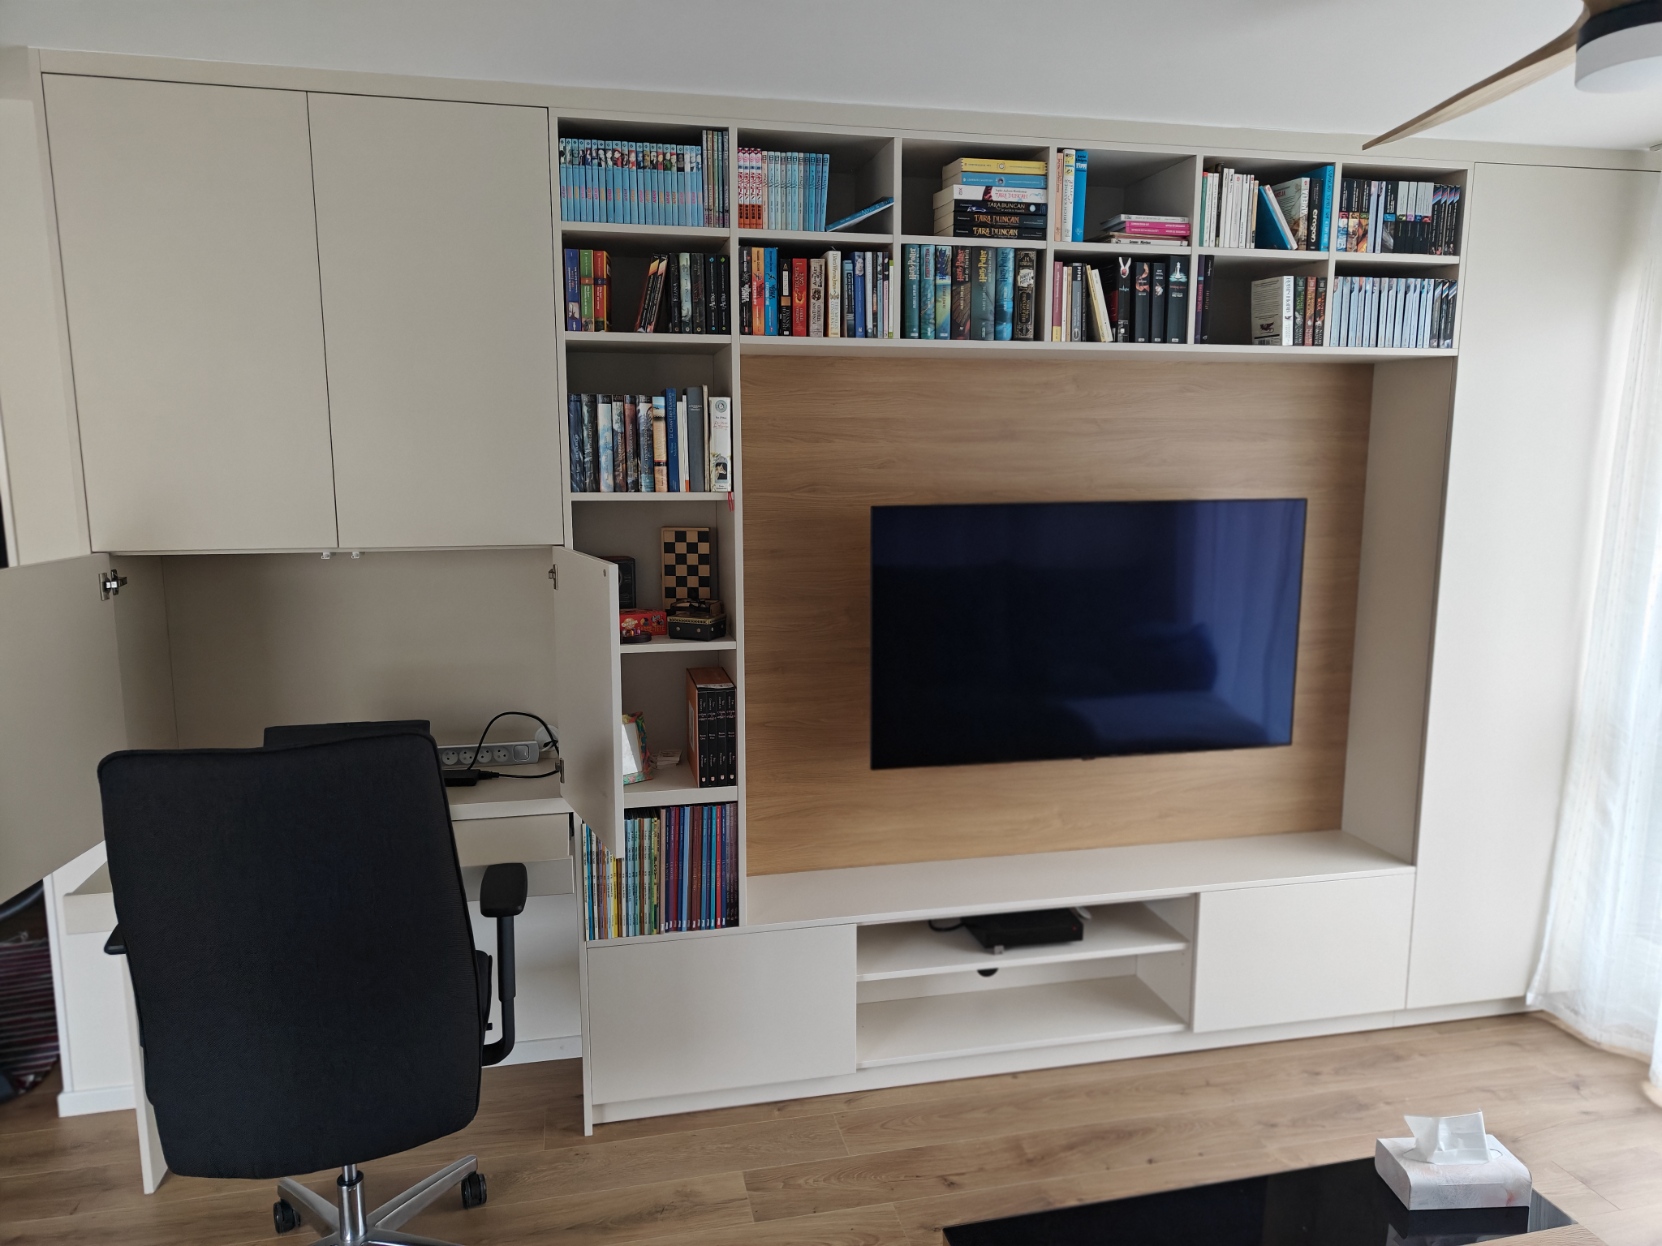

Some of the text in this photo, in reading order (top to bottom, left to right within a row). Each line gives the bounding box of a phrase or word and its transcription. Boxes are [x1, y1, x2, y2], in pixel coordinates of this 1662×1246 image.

[973, 227, 991, 236] TARA
[974, 215, 991, 225] TARA
[1310, 209, 1318, 242] eragon
[908, 248, 917, 280] Harry Potter
[956, 249, 965, 281] Harry Potter
[978, 250, 987, 282] Harry Potter
